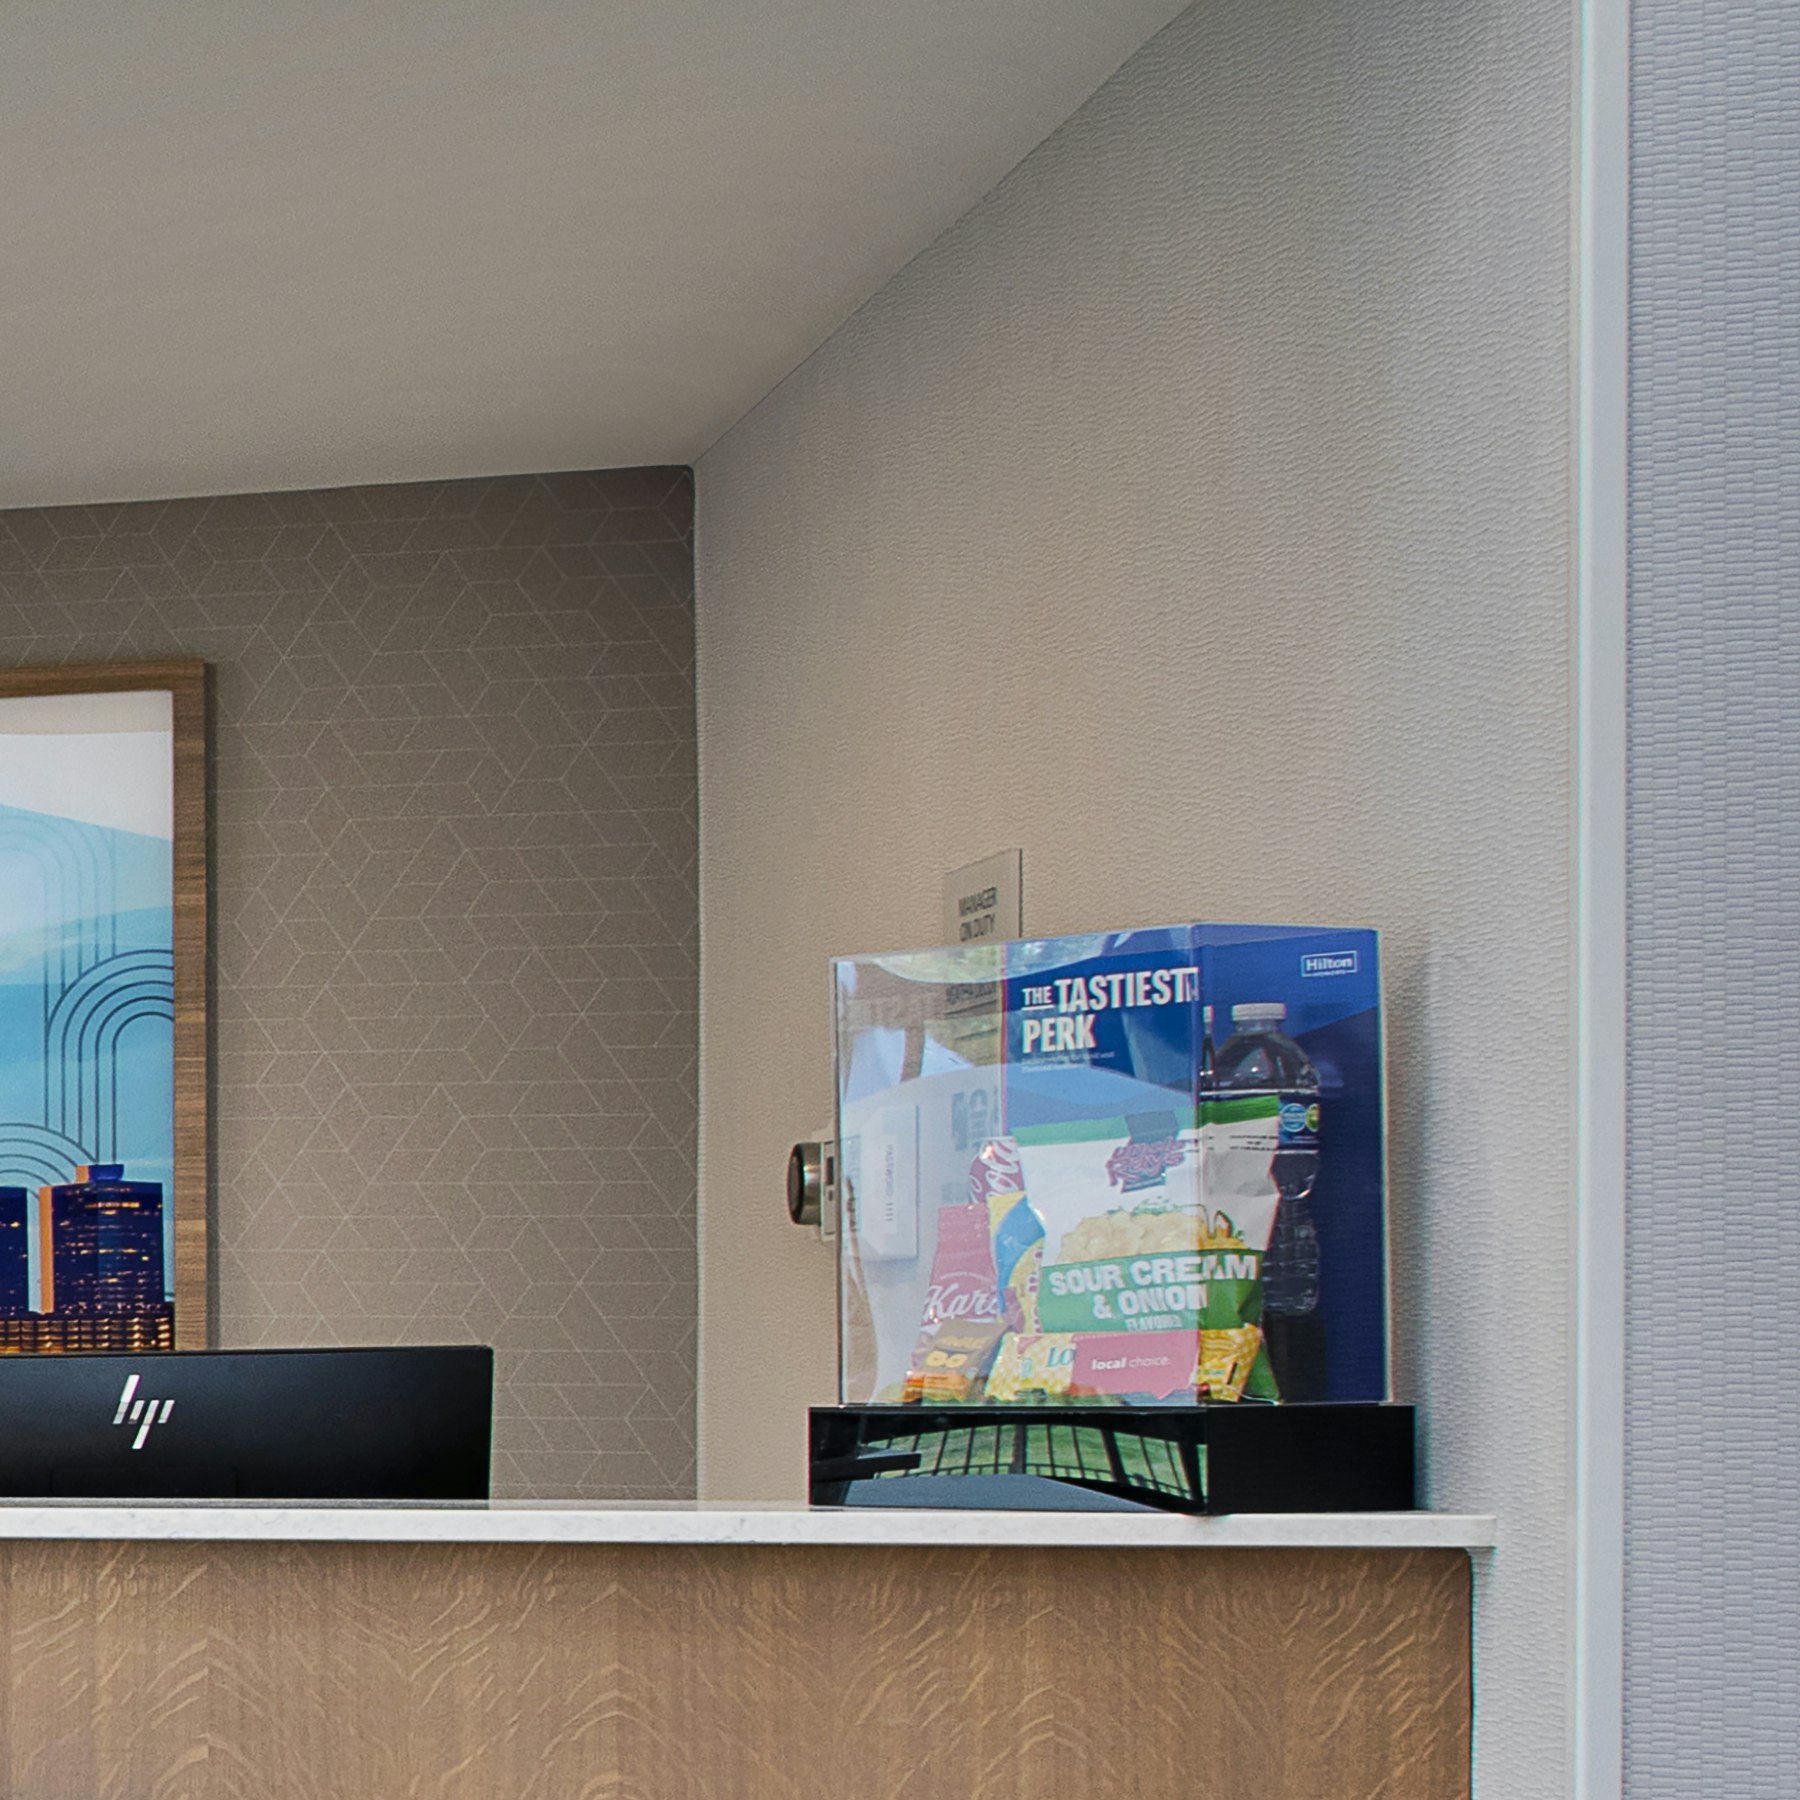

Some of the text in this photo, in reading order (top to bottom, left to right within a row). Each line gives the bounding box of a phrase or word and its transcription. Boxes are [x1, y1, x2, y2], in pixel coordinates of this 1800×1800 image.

[1305, 957, 1353, 971] Hilton
[1022, 986, 1052, 1006] THE
[1054, 967, 1197, 1013] TASTIEST
[1022, 1014, 1096, 1053] PERK
[1049, 1254, 1258, 1296] SOUR CREAM
[1092, 1283, 1208, 1319] & ONION
[1091, 1357, 1126, 1371] local
